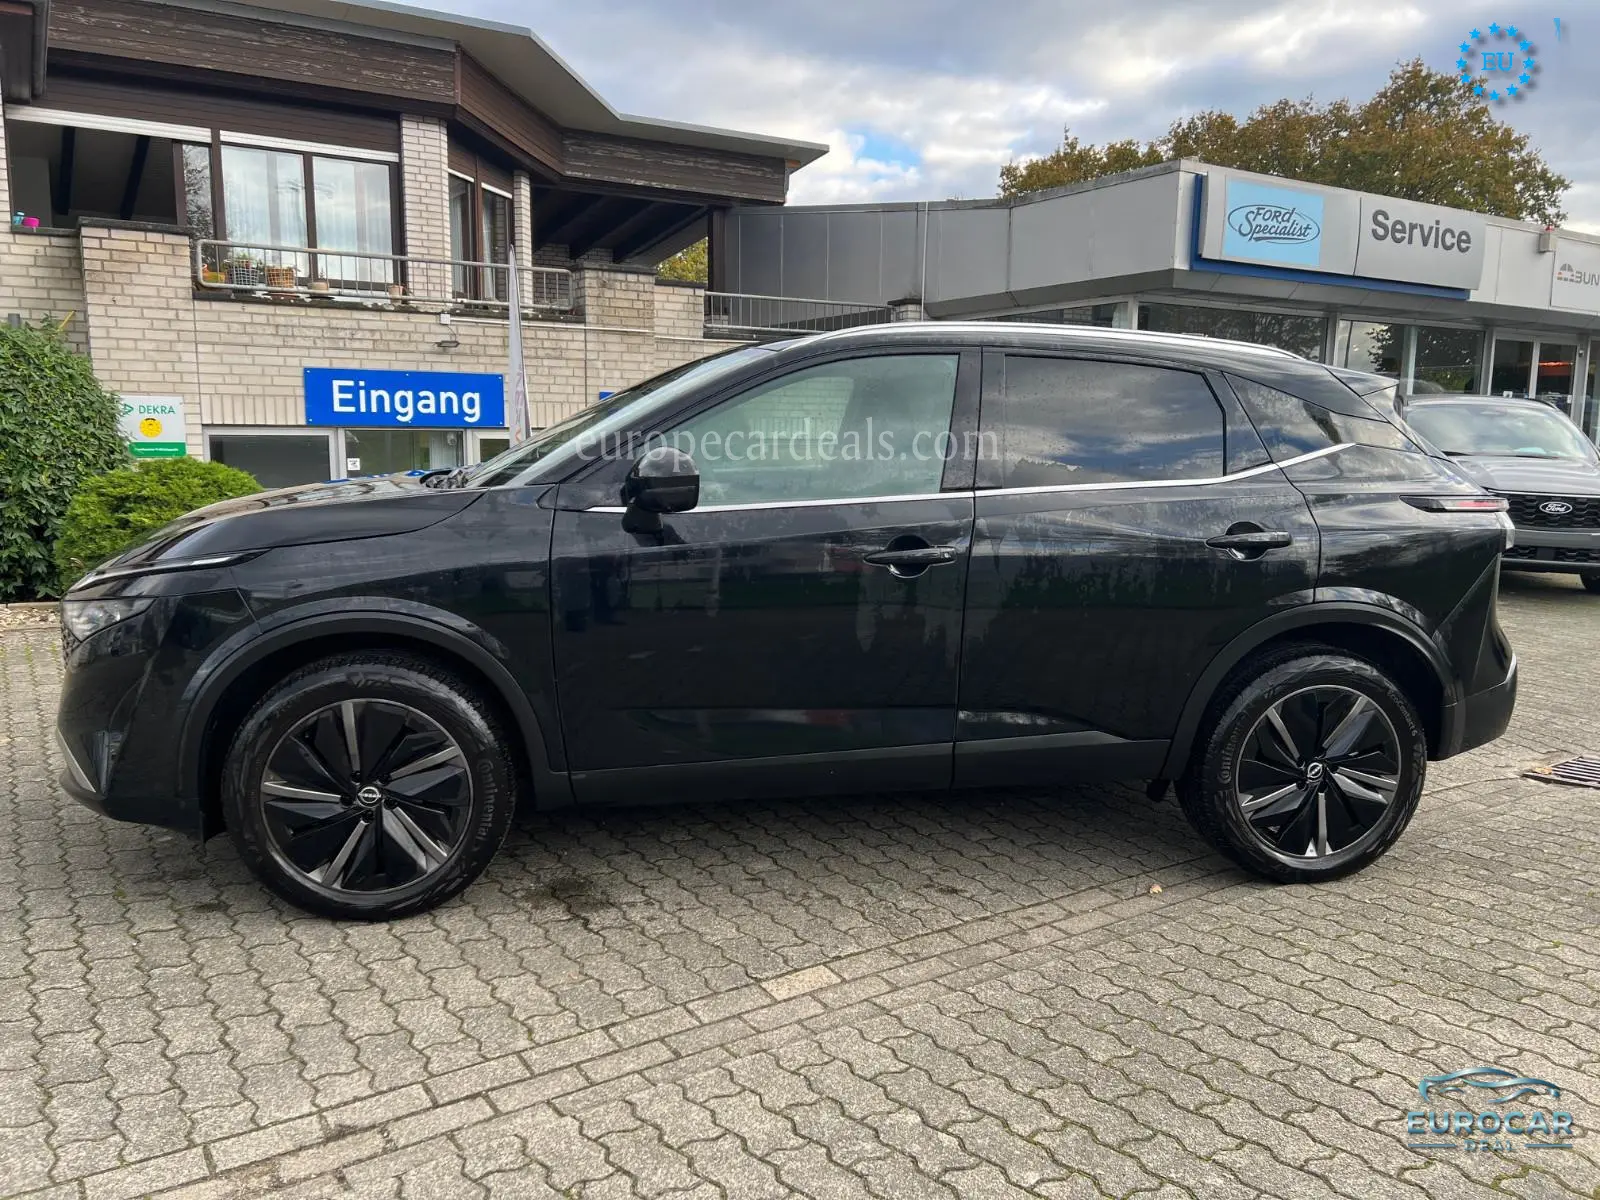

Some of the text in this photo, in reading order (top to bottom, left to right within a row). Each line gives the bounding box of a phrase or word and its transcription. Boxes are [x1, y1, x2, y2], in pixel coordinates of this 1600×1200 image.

[1238, 210, 1312, 241] Specialist
[1371, 209, 1472, 253] Service
[138, 404, 176, 415] DEKRA
[332, 379, 481, 422] Eingang
